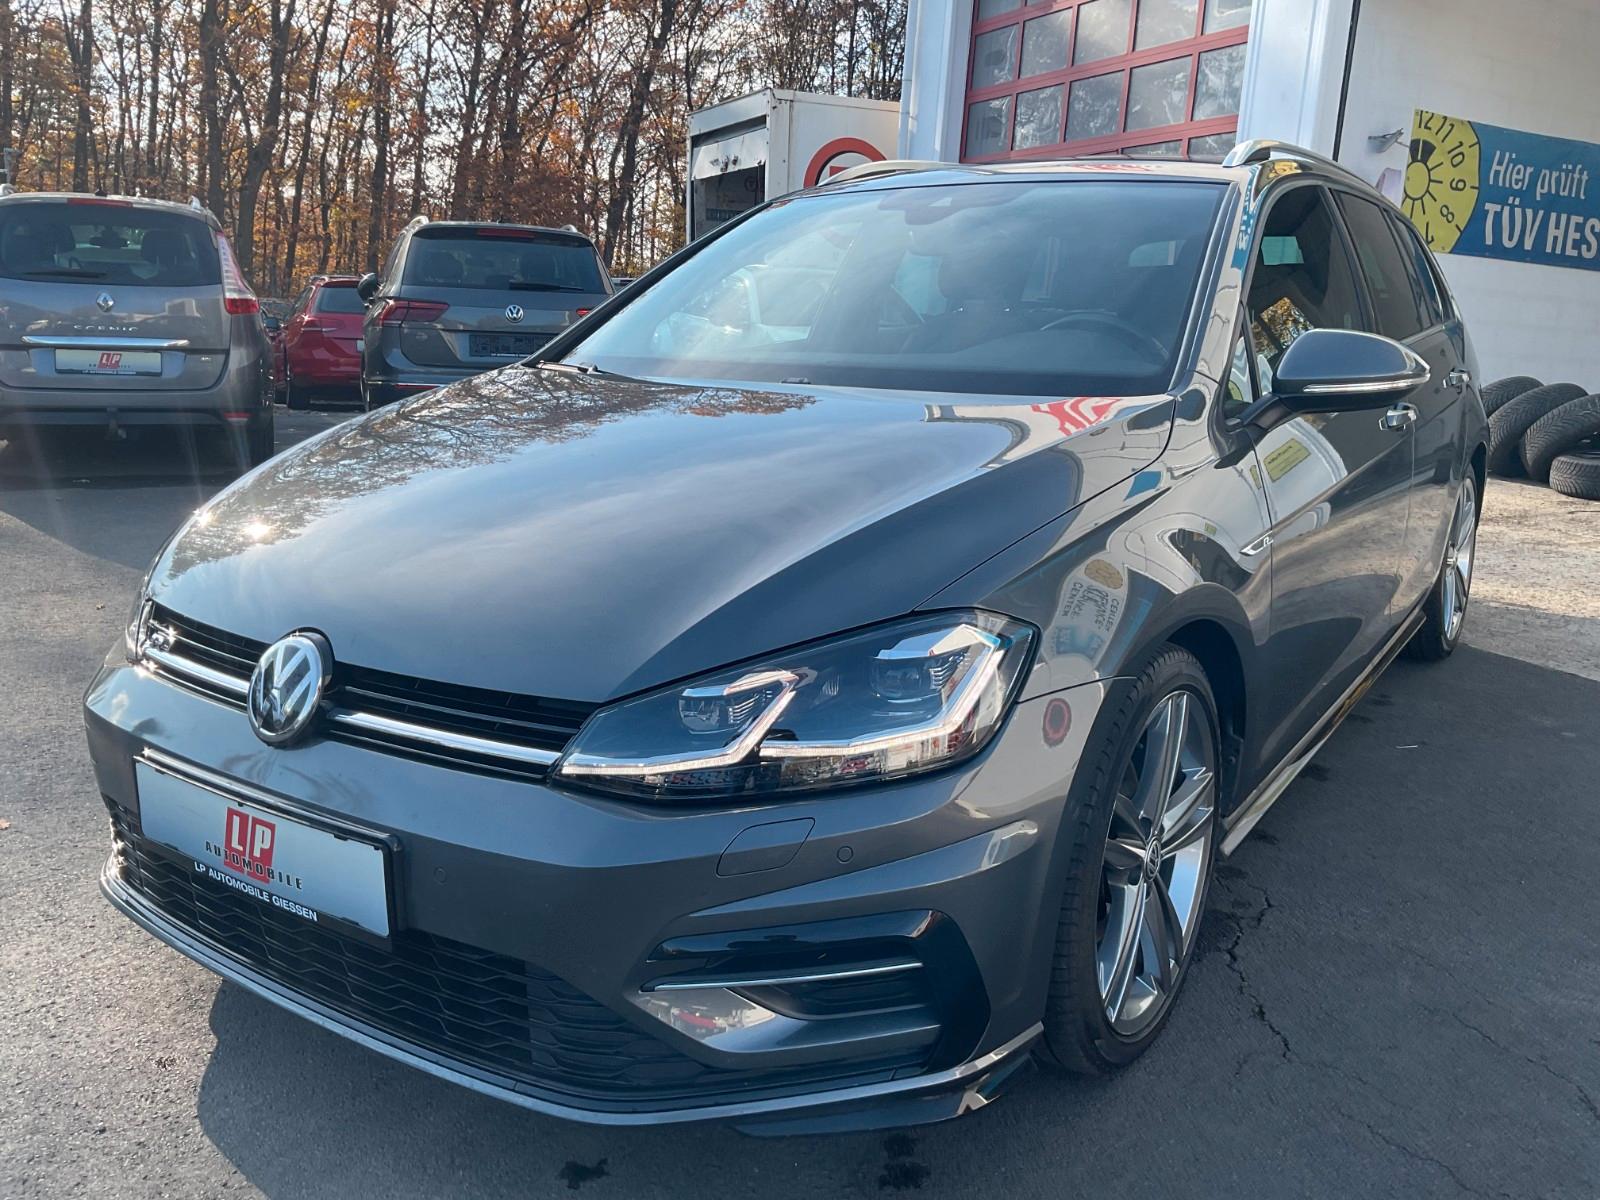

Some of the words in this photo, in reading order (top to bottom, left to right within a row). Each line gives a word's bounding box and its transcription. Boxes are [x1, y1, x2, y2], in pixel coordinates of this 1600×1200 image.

[1447, 140, 1466, 169] 10
[1489, 150, 1533, 191] Hier
[1536, 164, 1589, 201] prüft
[1439, 204, 1455, 224] 8
[1484, 196, 1544, 250] TÜV
[230, 814, 273, 858] LP
[204, 840, 304, 890] AUTOMOBILE
[193, 861, 206, 873] LP
[208, 867, 270, 903] AUTOMOBILE
[272, 894, 319, 922] GIESSEN
